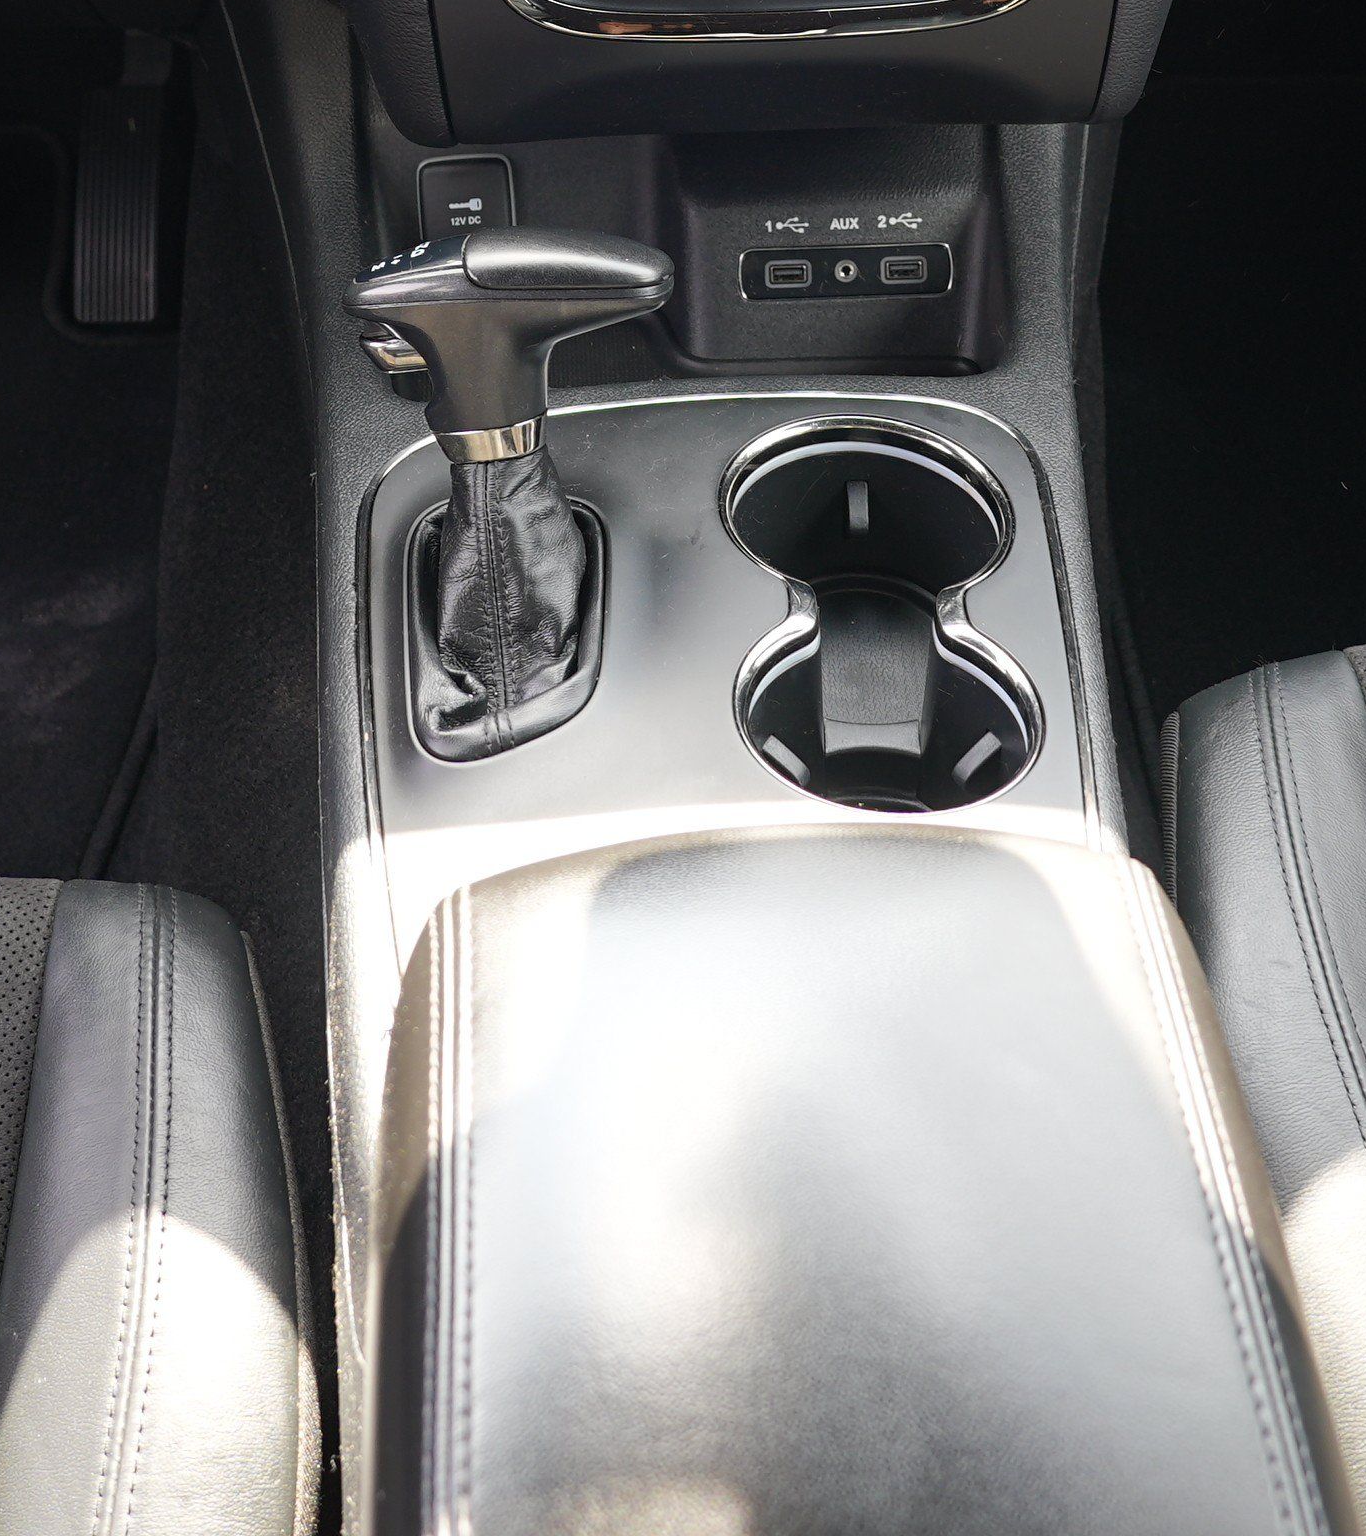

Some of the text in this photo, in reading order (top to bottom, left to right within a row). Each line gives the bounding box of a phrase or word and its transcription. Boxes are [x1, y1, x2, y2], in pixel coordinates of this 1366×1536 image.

[450, 215, 481, 227] 12V DC
[765, 220, 772, 232] 1
[830, 217, 859, 230] AUX
[877, 215, 887, 228] 2
